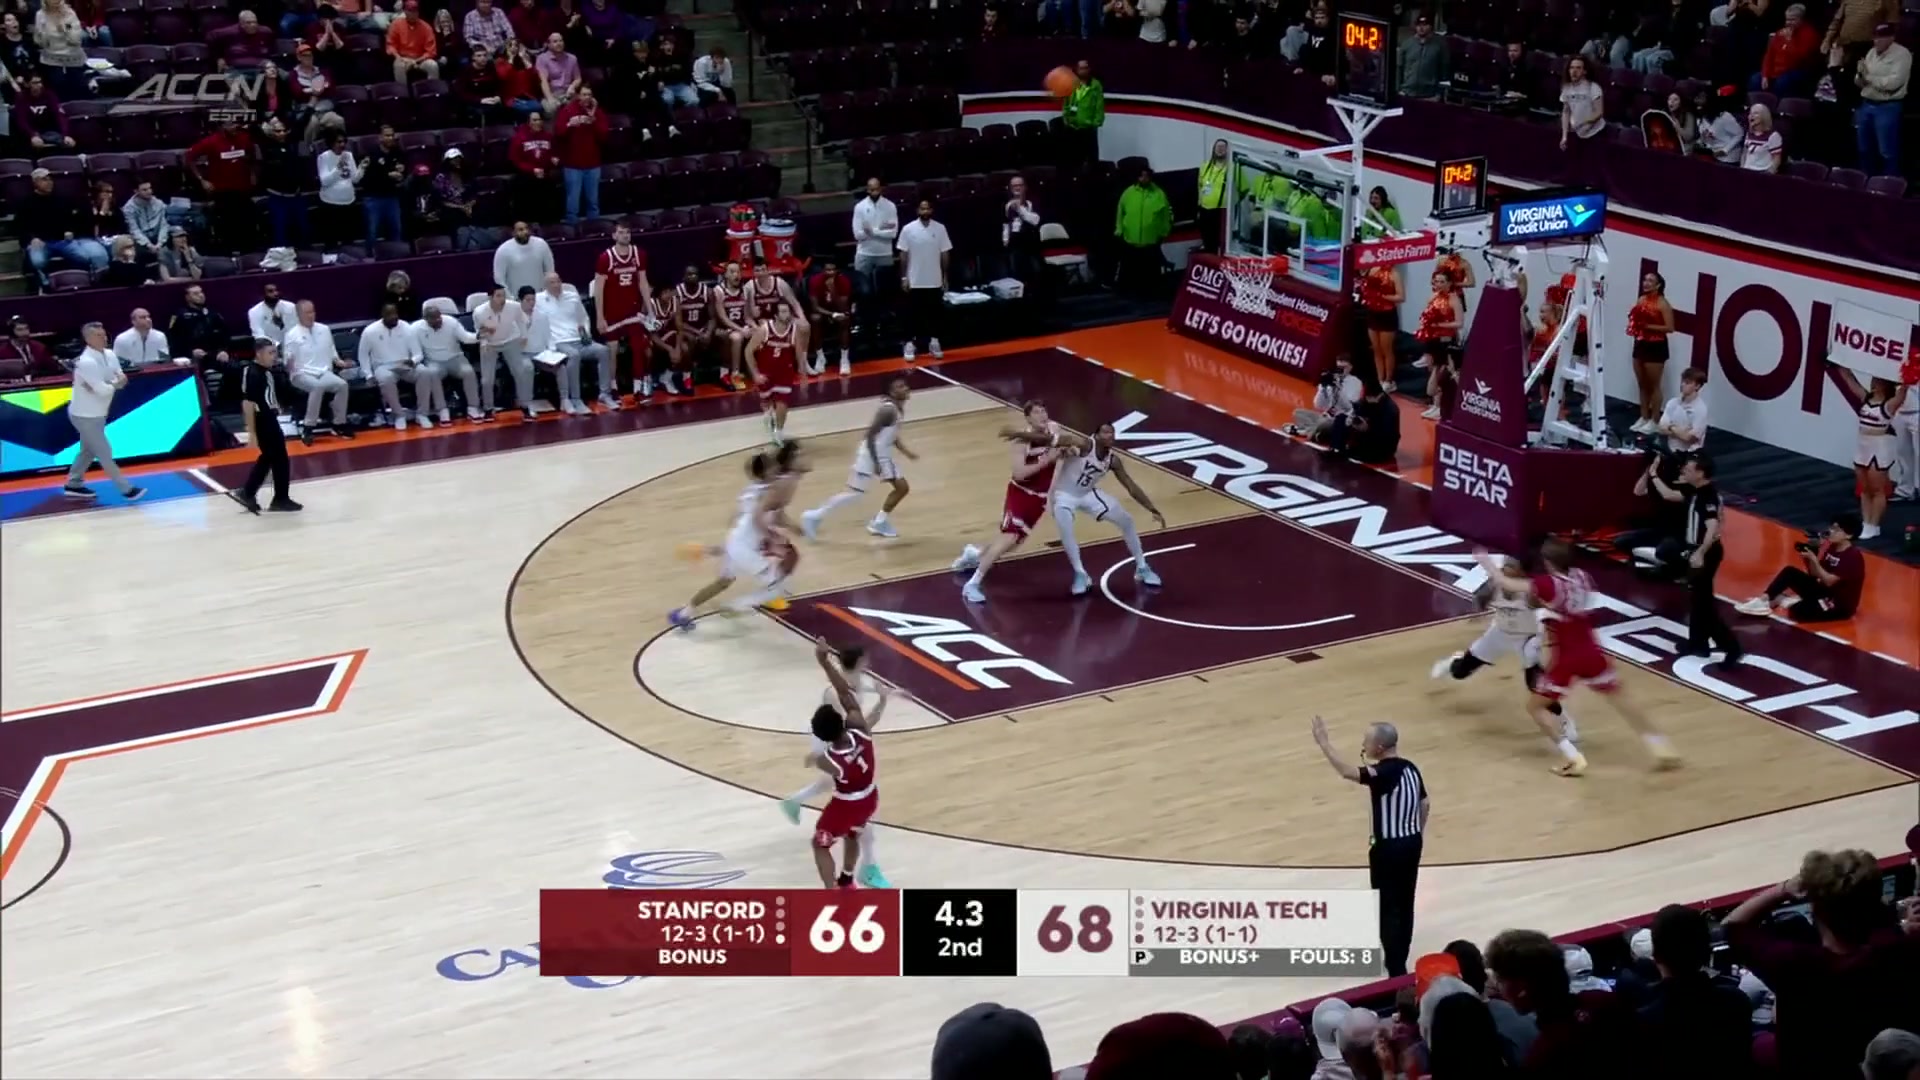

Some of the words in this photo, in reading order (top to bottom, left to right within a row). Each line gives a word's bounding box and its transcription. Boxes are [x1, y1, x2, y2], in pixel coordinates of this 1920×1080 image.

[1345, 23, 1378, 50] 04.2
[1506, 221, 1539, 236] Credit
[1539, 219, 1568, 232] Union
[1508, 204, 1563, 223] VIRGINIA
[1191, 264, 1224, 288] CMG
[1294, 299, 1330, 323] Housing
[1184, 306, 1221, 335] LET'S
[1220, 320, 1246, 344] GO
[1245, 329, 1309, 369] HOKIES!
[1833, 322, 1905, 361] NOISE
[1439, 442, 1514, 488] DELTA
[1105, 410, 1508, 594] VIRGINIA
[1443, 468, 1508, 509] STAR
[847, 606, 1074, 690] ACC
